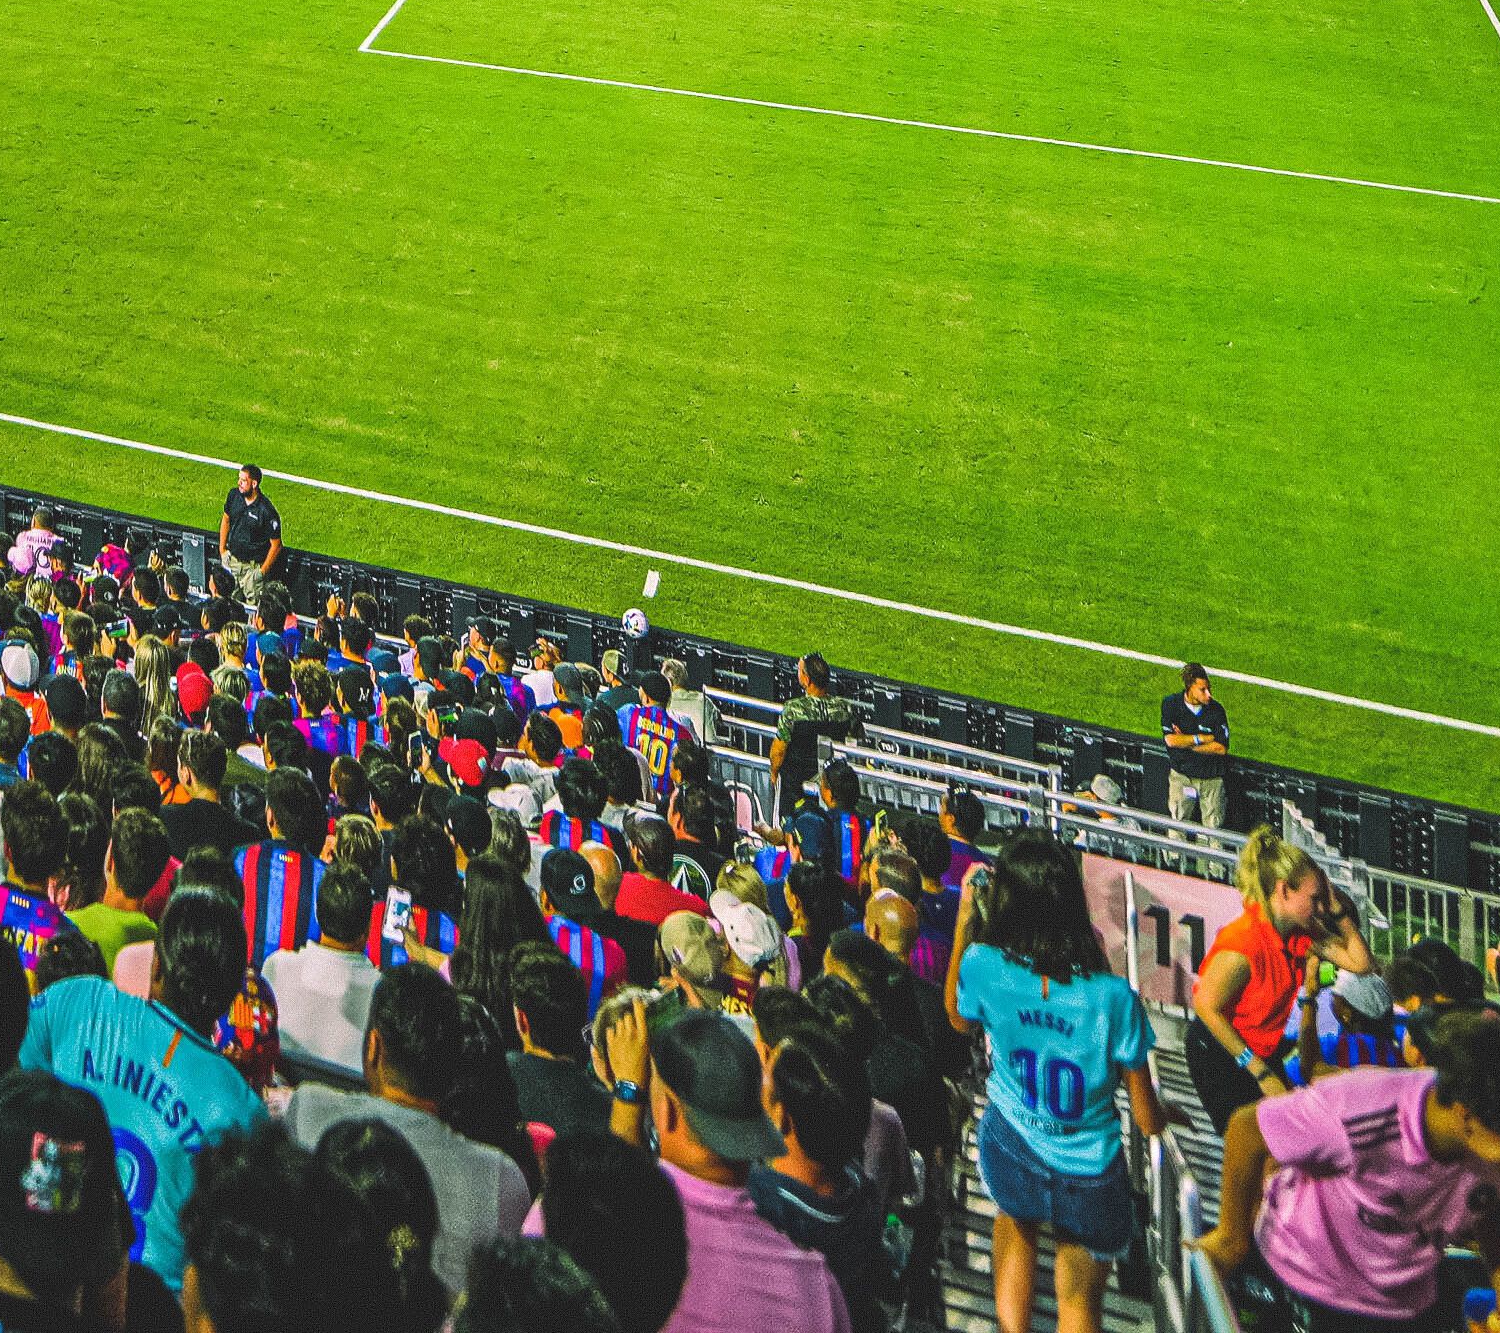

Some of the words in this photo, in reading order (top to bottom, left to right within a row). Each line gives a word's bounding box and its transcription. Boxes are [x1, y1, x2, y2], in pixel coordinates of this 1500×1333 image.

[1018, 1008, 1075, 1039] MESSI
[113, 1057, 205, 1151] INIEST
[1009, 1048, 1088, 1123] 10
